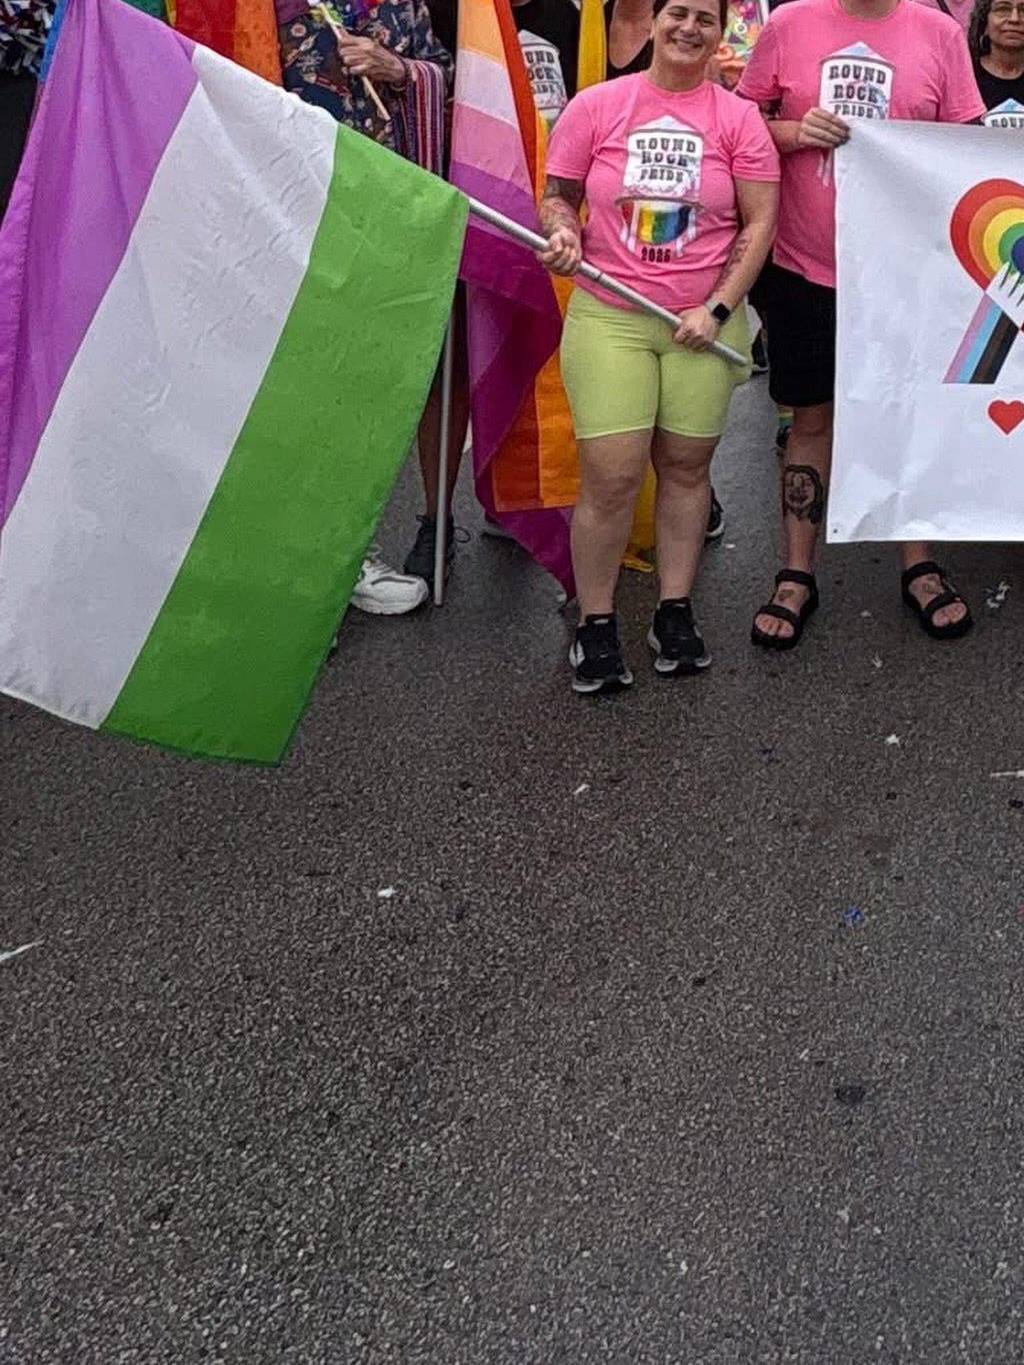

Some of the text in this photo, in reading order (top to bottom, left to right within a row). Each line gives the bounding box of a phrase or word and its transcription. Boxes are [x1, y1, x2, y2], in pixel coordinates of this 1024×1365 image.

[525, 50, 555, 64] UND
[527, 66, 555, 80] OCK
[829, 64, 886, 84] ROUND
[833, 84, 879, 103] ROCK
[834, 104, 874, 118] PRIDE
[636, 138, 696, 153] ROUND
[641, 152, 688, 167] ROCK
[640, 169, 683, 183] PRIDE
